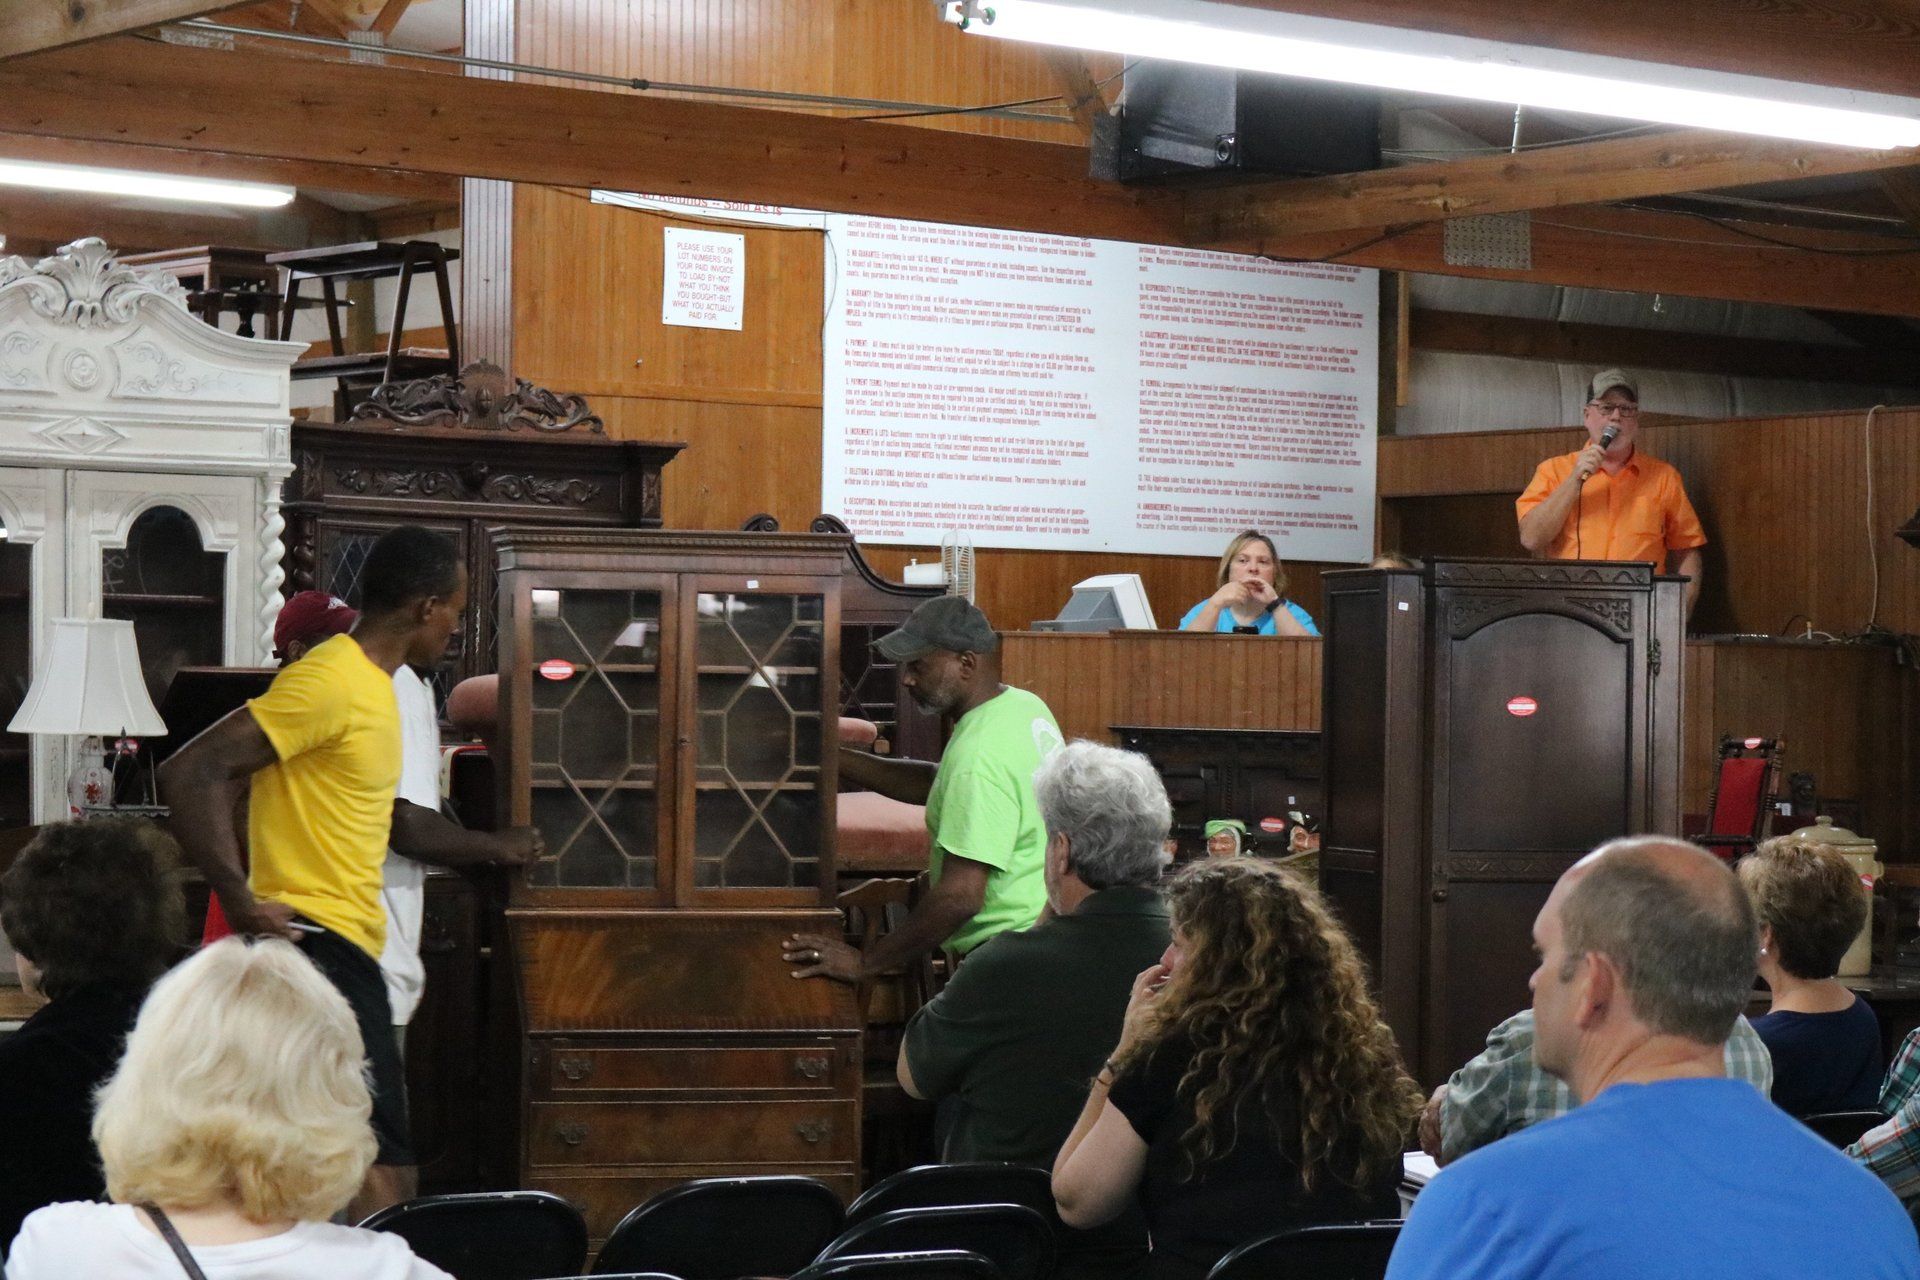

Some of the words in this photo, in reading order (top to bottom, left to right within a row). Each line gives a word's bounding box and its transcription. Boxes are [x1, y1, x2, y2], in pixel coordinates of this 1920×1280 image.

[755, 204, 768, 214] As
[773, 206, 783, 215] Is
[677, 242, 700, 251] PLEASE
[717, 246, 733, 254] YOUR
[678, 252, 690, 260] LOT
[692, 254, 721, 263] NUMBERS
[724, 256, 732, 264] ON
[695, 263, 709, 271] PAID
[710, 265, 734, 274] INVOICE
[690, 273, 705, 281] LOAD
[698, 283, 710, 291] YOU
[706, 303, 735, 312] ACTUALLY
[689, 311, 702, 319] PAID
